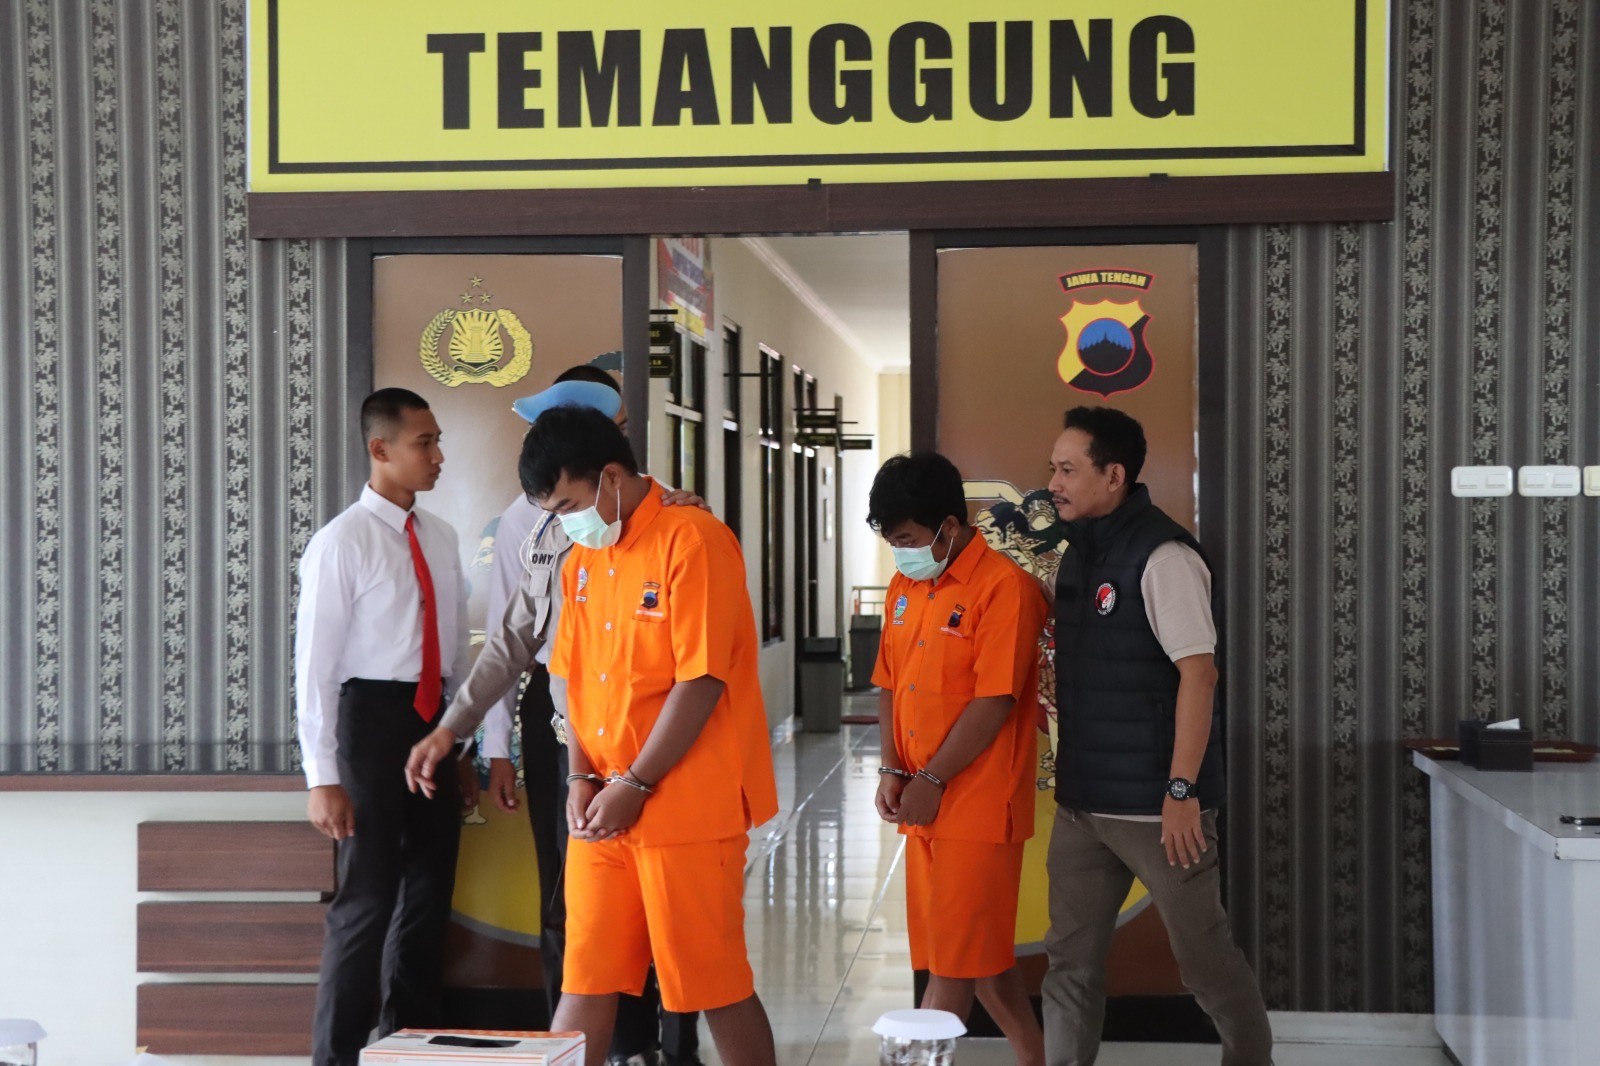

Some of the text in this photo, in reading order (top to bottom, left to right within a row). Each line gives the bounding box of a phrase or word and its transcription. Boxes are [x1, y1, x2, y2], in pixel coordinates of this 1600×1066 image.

[426, 15, 1196, 130] TEMANGGUNG
[1066, 272, 1147, 288] JAWA TENGAH
